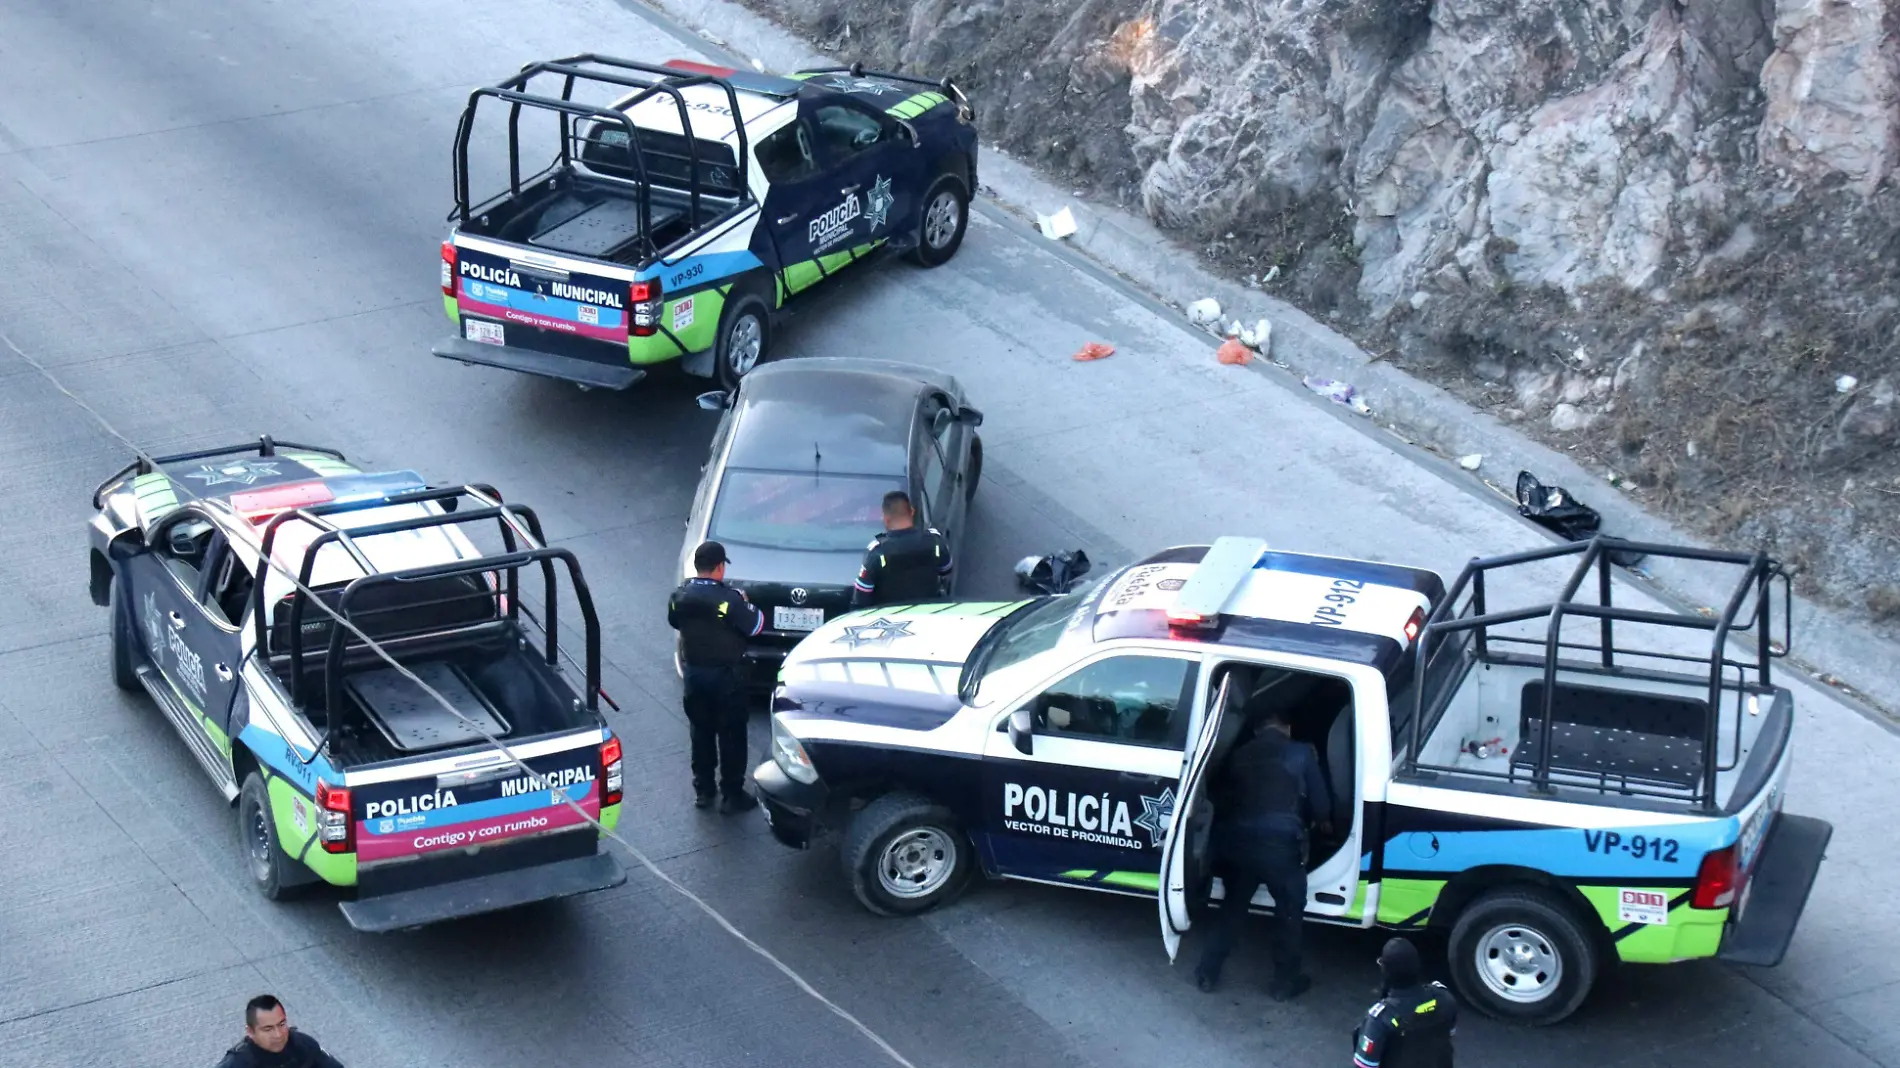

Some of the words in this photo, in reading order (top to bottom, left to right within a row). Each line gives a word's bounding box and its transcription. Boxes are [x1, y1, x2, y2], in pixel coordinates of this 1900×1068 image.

[809, 192, 861, 243] POLICÍA
[460, 260, 521, 288] POLICÍA
[552, 281, 623, 308] MUNICIPAL
[671, 263, 704, 287] VP-930
[539, 319, 552, 327] con
[552, 321, 576, 332] rumbo
[1310, 579, 1365, 625] VP-912
[366, 788, 458, 819] POLICÍA
[501, 765, 596, 797] MUNICIPAL
[1004, 782, 1134, 838] POLICÍA
[413, 832, 466, 849] Contigo
[467, 830, 475, 842] y
[479, 825, 502, 837] con
[504, 816, 548, 833] rumbo
[1004, 820, 1051, 836] VECTOR
[1053, 827, 1069, 838] DE
[1072, 830, 1143, 850] PROXIMIDAD
[1583, 828, 1680, 864] VP-912
[1624, 892, 1663, 907] 911
